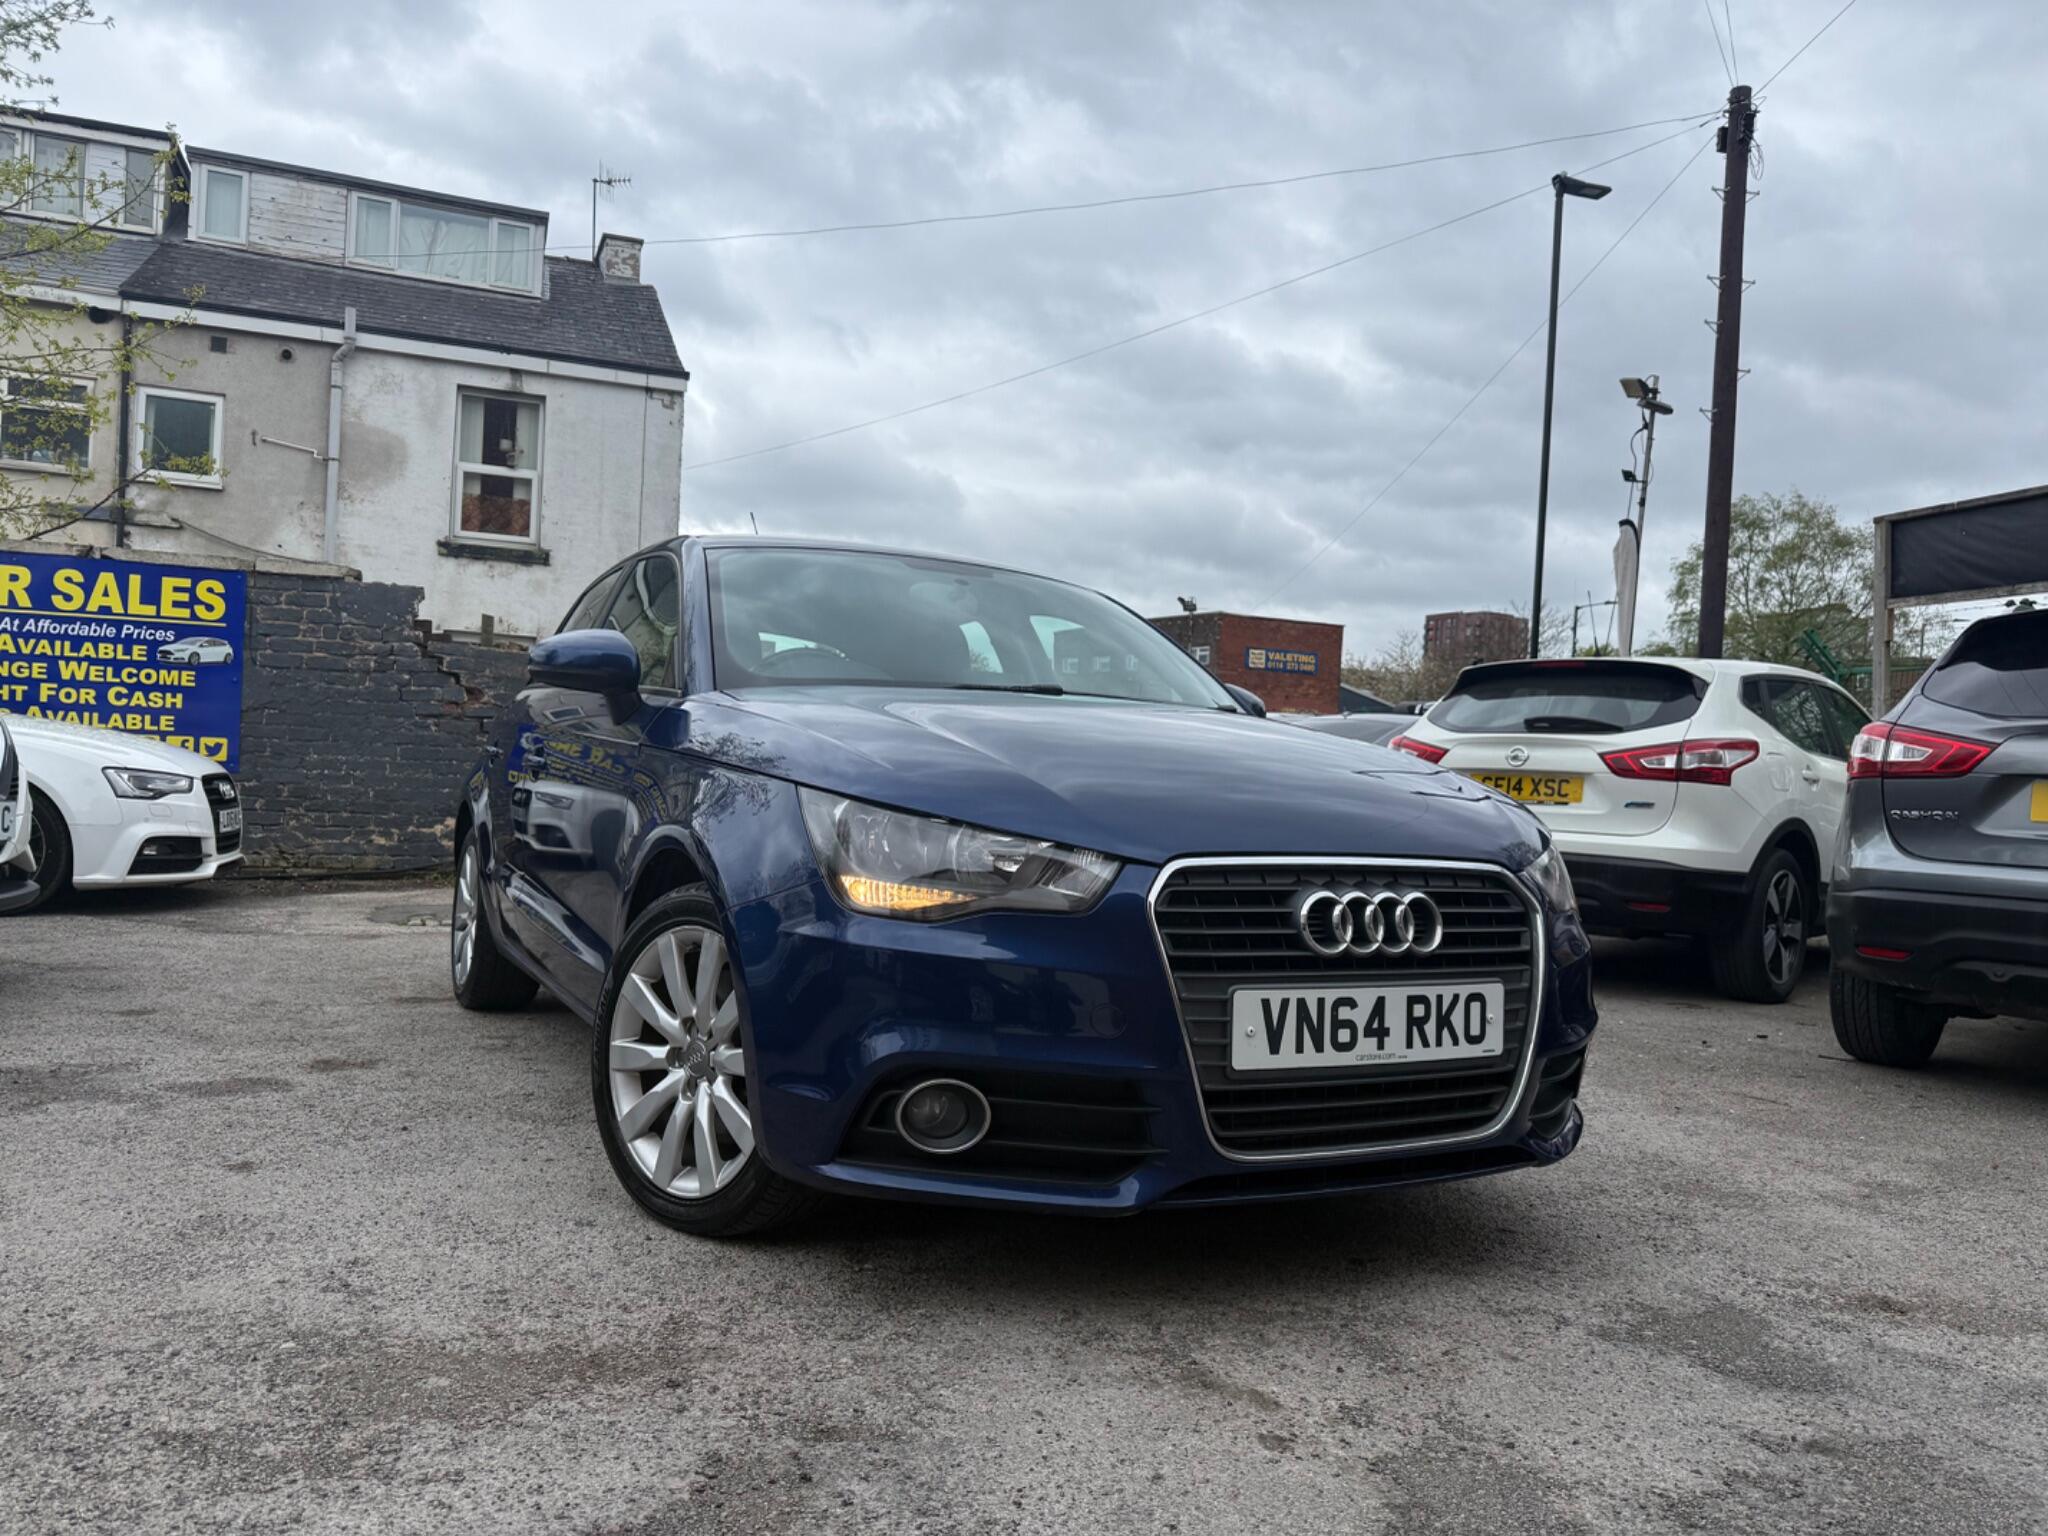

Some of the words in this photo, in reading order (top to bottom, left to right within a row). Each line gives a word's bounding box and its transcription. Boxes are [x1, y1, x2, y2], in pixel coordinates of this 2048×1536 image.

[51, 568, 227, 621] SALES
[0, 616, 19, 633] At
[23, 618, 117, 638] Affordable
[121, 625, 176, 642] Prices
[58, 660, 196, 687] WELCOME
[39, 682, 97, 705] FOR
[107, 686, 183, 709] CASH
[1529, 776, 1571, 799] XSC
[1260, 995, 1391, 1056] VN64
[1405, 991, 1487, 1050] RKO
